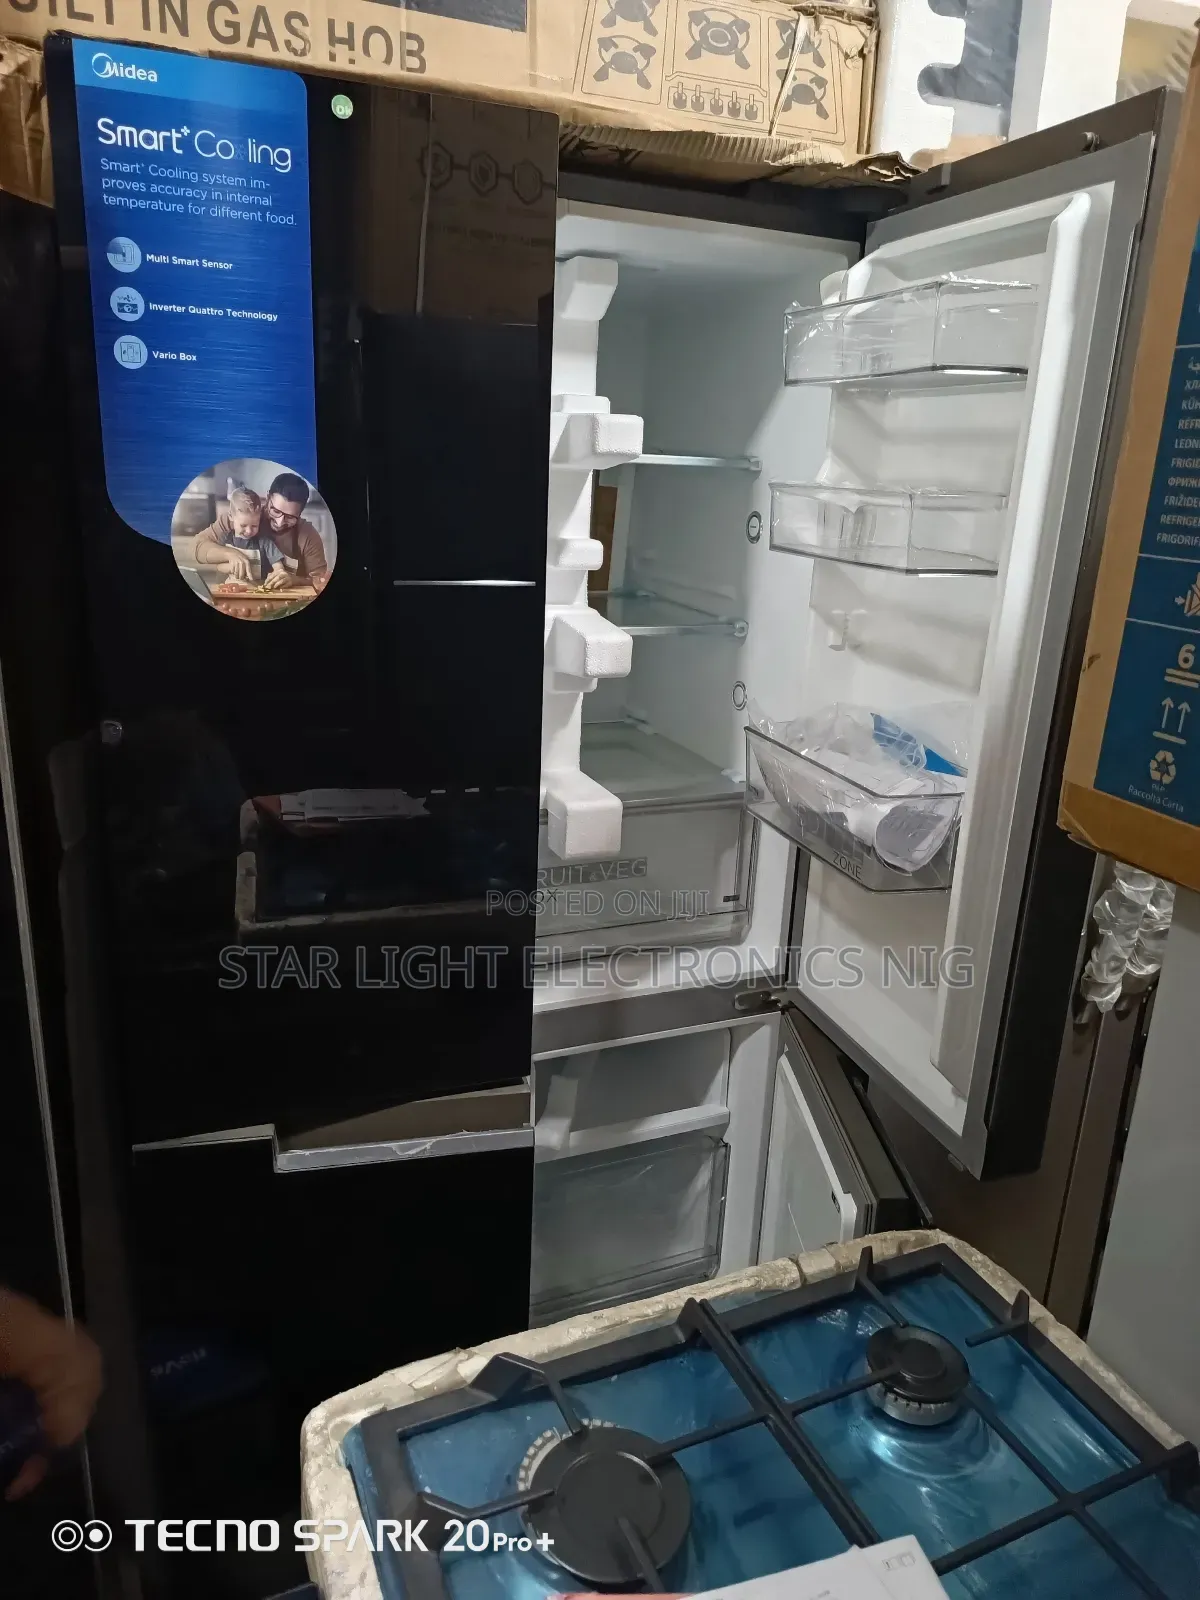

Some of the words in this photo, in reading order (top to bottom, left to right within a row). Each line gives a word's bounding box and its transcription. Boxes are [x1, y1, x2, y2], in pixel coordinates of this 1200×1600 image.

[142, 0, 189, 37] IN
[207, 0, 311, 57] GAS
[328, 18, 427, 74] HOB
[92, 53, 158, 82] Midea
[148, 164, 198, 182] Cooling
[202, 173, 247, 188] system
[250, 177, 270, 189] im-
[102, 177, 146, 192] proves
[150, 183, 207, 200] accuracy
[211, 188, 223, 201] in
[226, 190, 272, 206] internal
[103, 193, 184, 213] temperature
[188, 202, 206, 215] for
[210, 205, 262, 222] different
[266, 211, 297, 226] food.
[146, 253, 169, 265] Multi
[172, 255, 200, 267] Smart
[202, 258, 233, 270] Sensor
[149, 302, 186, 314] Inverter
[188, 305, 224, 317] Quattro
[226, 308, 278, 322] Technology
[152, 350, 177, 361] Vario
[179, 352, 197, 362] Box
[1178, 644, 1195, 669] 6
[600, 858, 646, 880] VEG
[833, 850, 862, 880] ZONE
